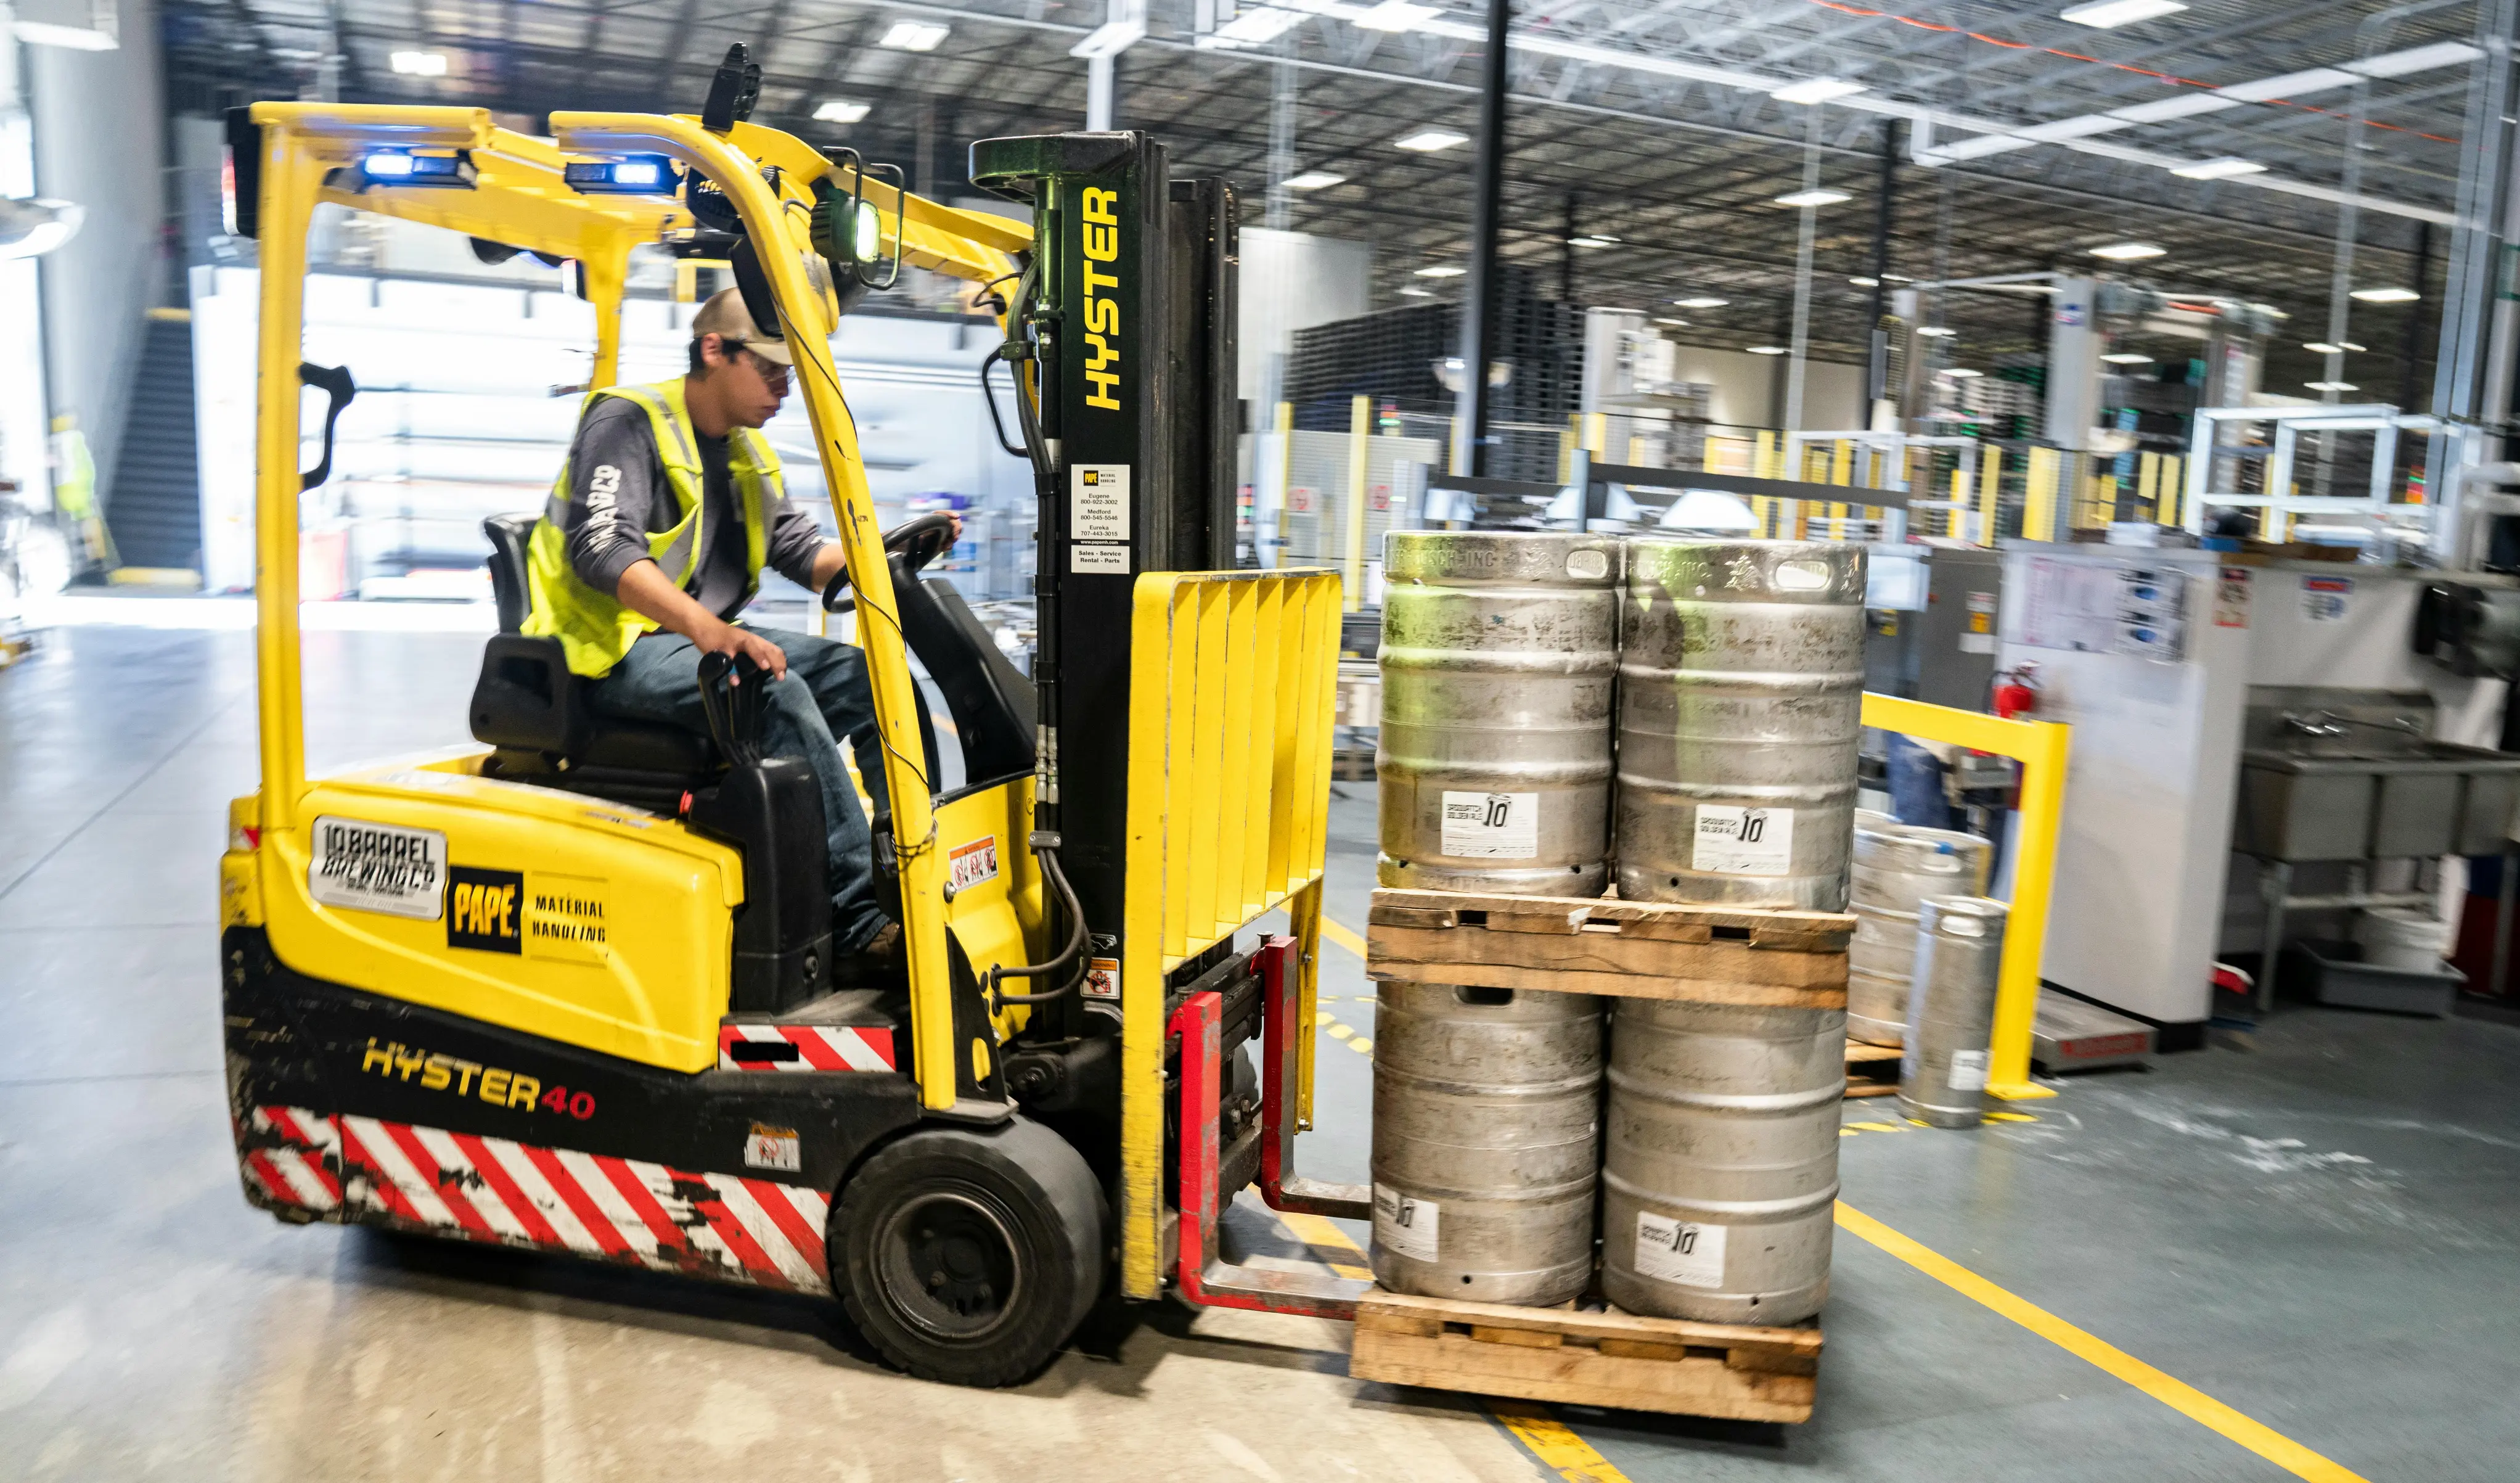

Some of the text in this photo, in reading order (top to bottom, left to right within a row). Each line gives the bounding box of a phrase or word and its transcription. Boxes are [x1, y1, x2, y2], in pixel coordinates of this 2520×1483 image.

[1082, 187, 1120, 410] HYSTER
[1483, 800, 1507, 828] 10
[1737, 815, 1764, 842] 10
[348, 828, 435, 865] BARREL
[535, 894, 605, 919] MATERIAL
[533, 920, 606, 943] HANDLING
[361, 1036, 596, 1120] HYSTER 40
